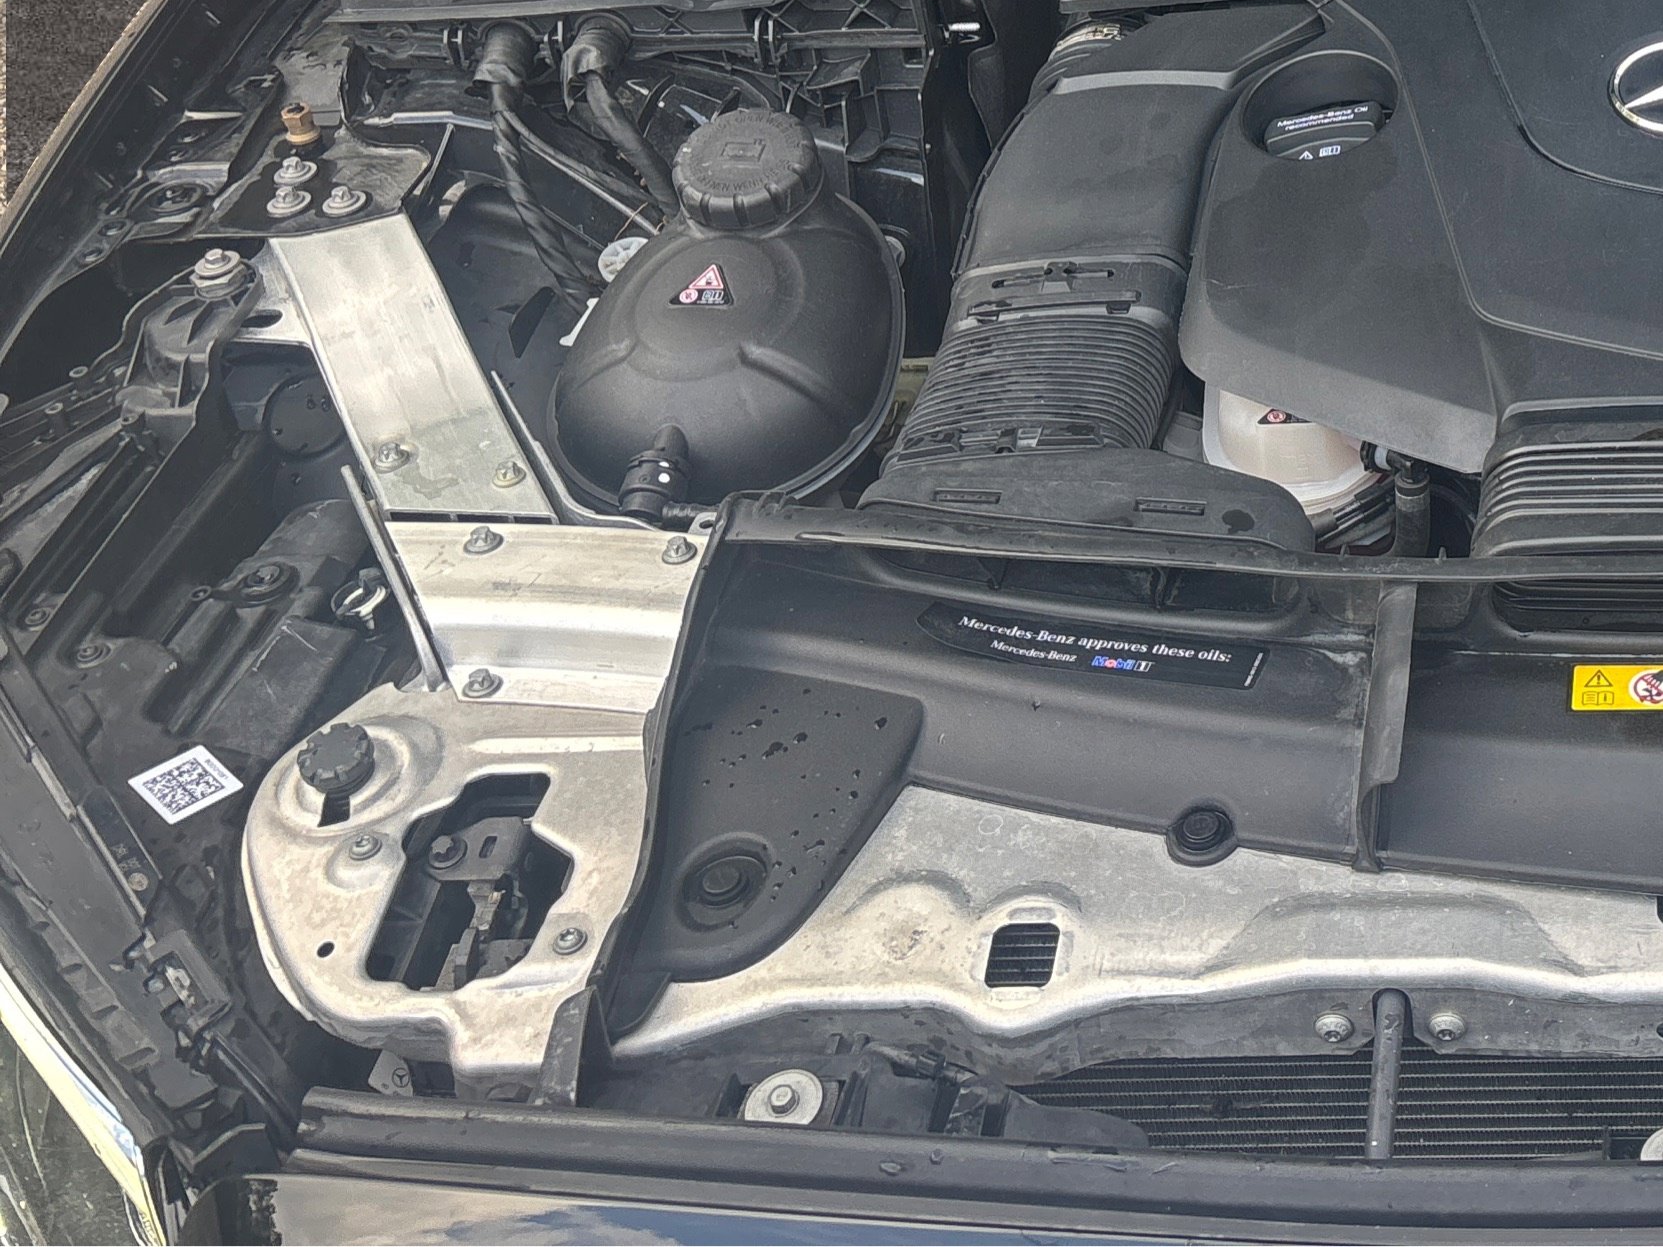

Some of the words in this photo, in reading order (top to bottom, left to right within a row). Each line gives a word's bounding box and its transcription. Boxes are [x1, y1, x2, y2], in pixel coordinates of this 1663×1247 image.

[958, 615, 1076, 645] Mercedes-Benz
[1077, 635, 1149, 654] approves
[1152, 643, 1195, 658] these
[1198, 648, 1232, 663] oils:
[990, 639, 1078, 663] Mercedes-Benz
[1091, 655, 1137, 671] Mobil
